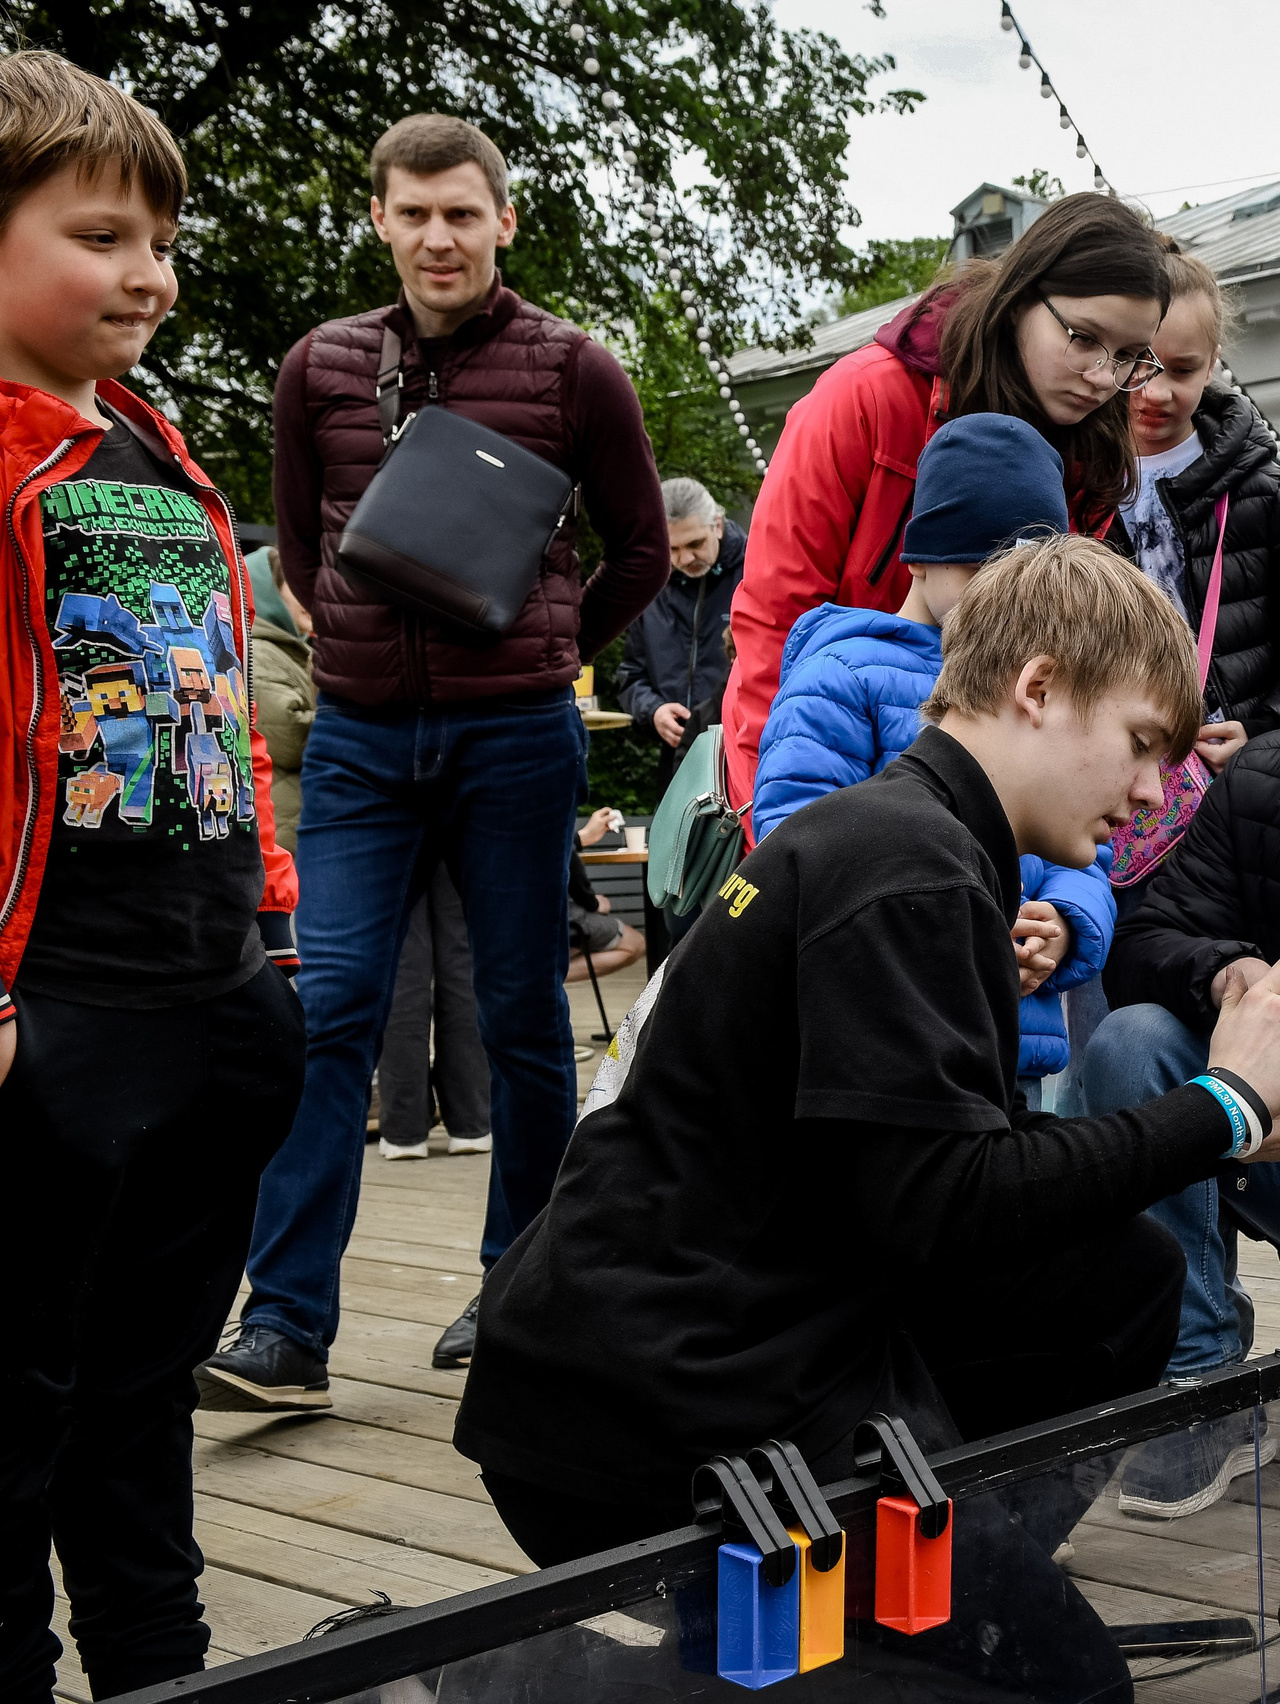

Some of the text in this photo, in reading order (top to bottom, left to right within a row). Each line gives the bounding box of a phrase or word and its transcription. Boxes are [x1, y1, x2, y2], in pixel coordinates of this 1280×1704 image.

[78, 516, 207, 536] THE EXHIBITION
[1229, 1106, 1245, 1137] North
